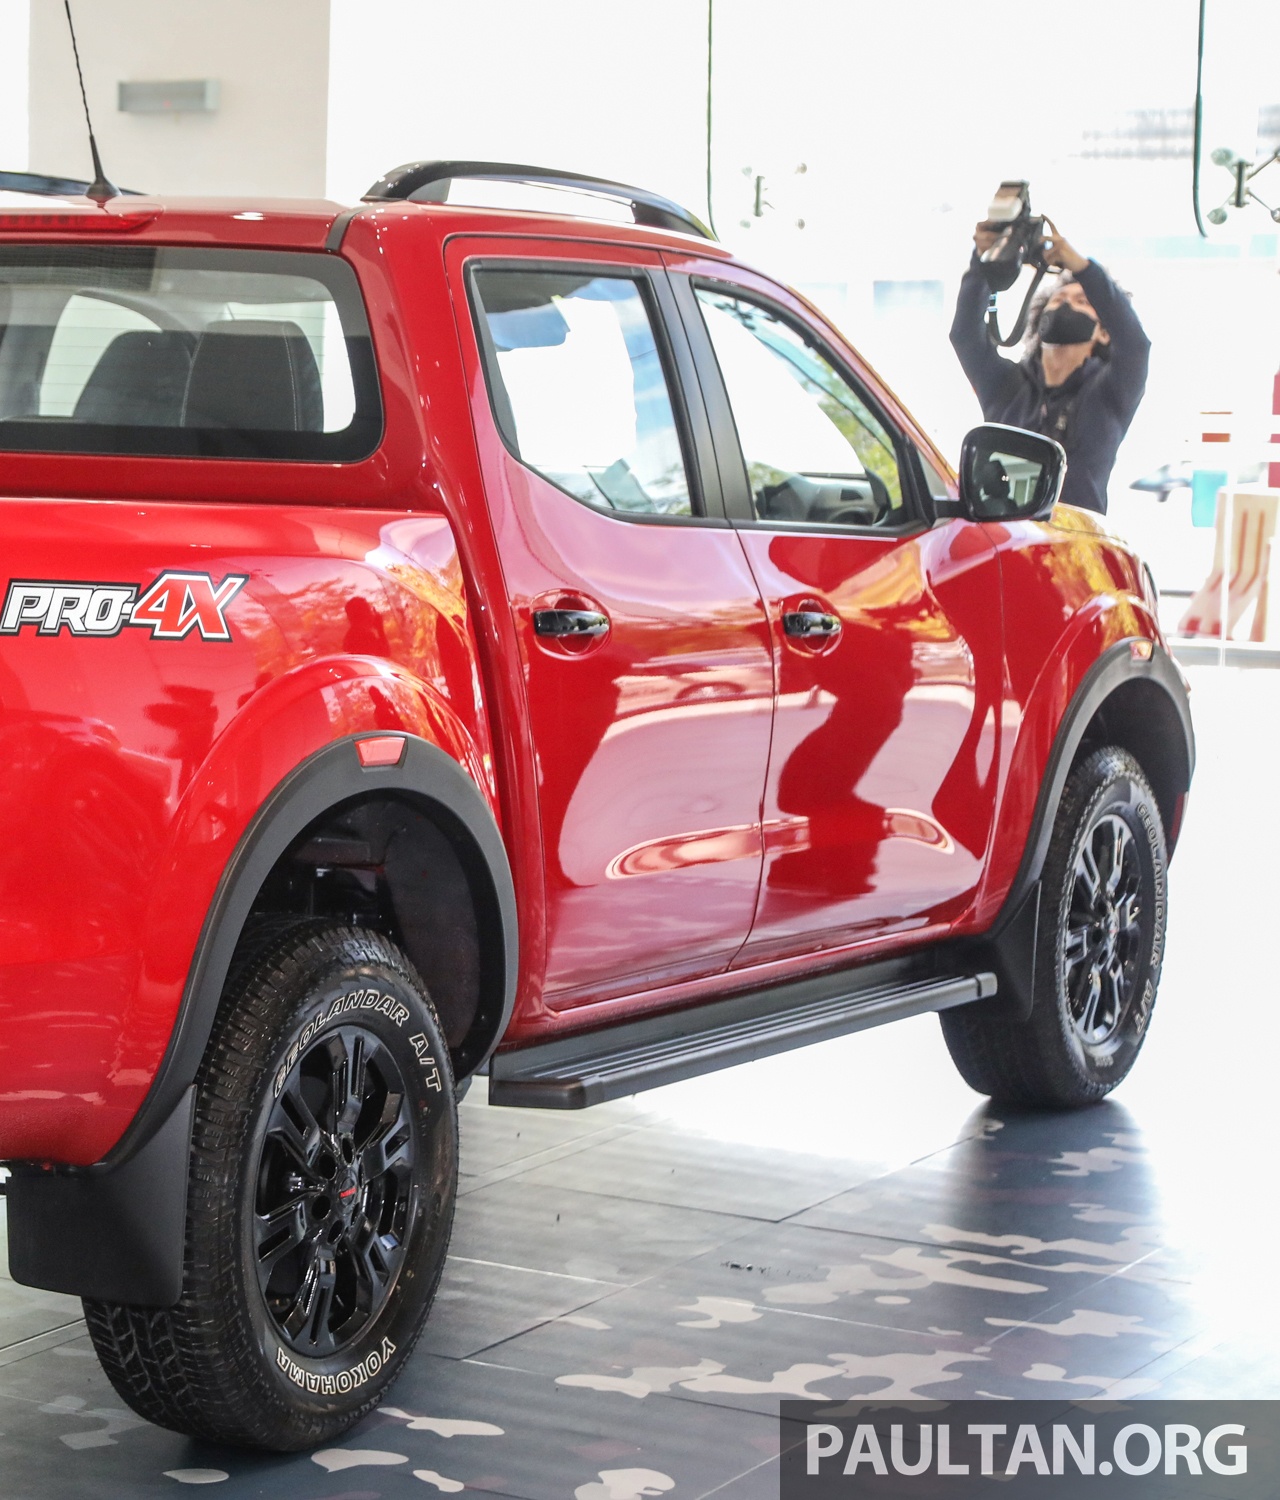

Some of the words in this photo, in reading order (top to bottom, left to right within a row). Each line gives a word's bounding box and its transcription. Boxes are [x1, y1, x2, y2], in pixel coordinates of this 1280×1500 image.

[273, 989, 410, 1099] GEOLANDAR
[408, 1032, 442, 1092] A/T
[276, 1336, 397, 1395] YOKOHAMA
